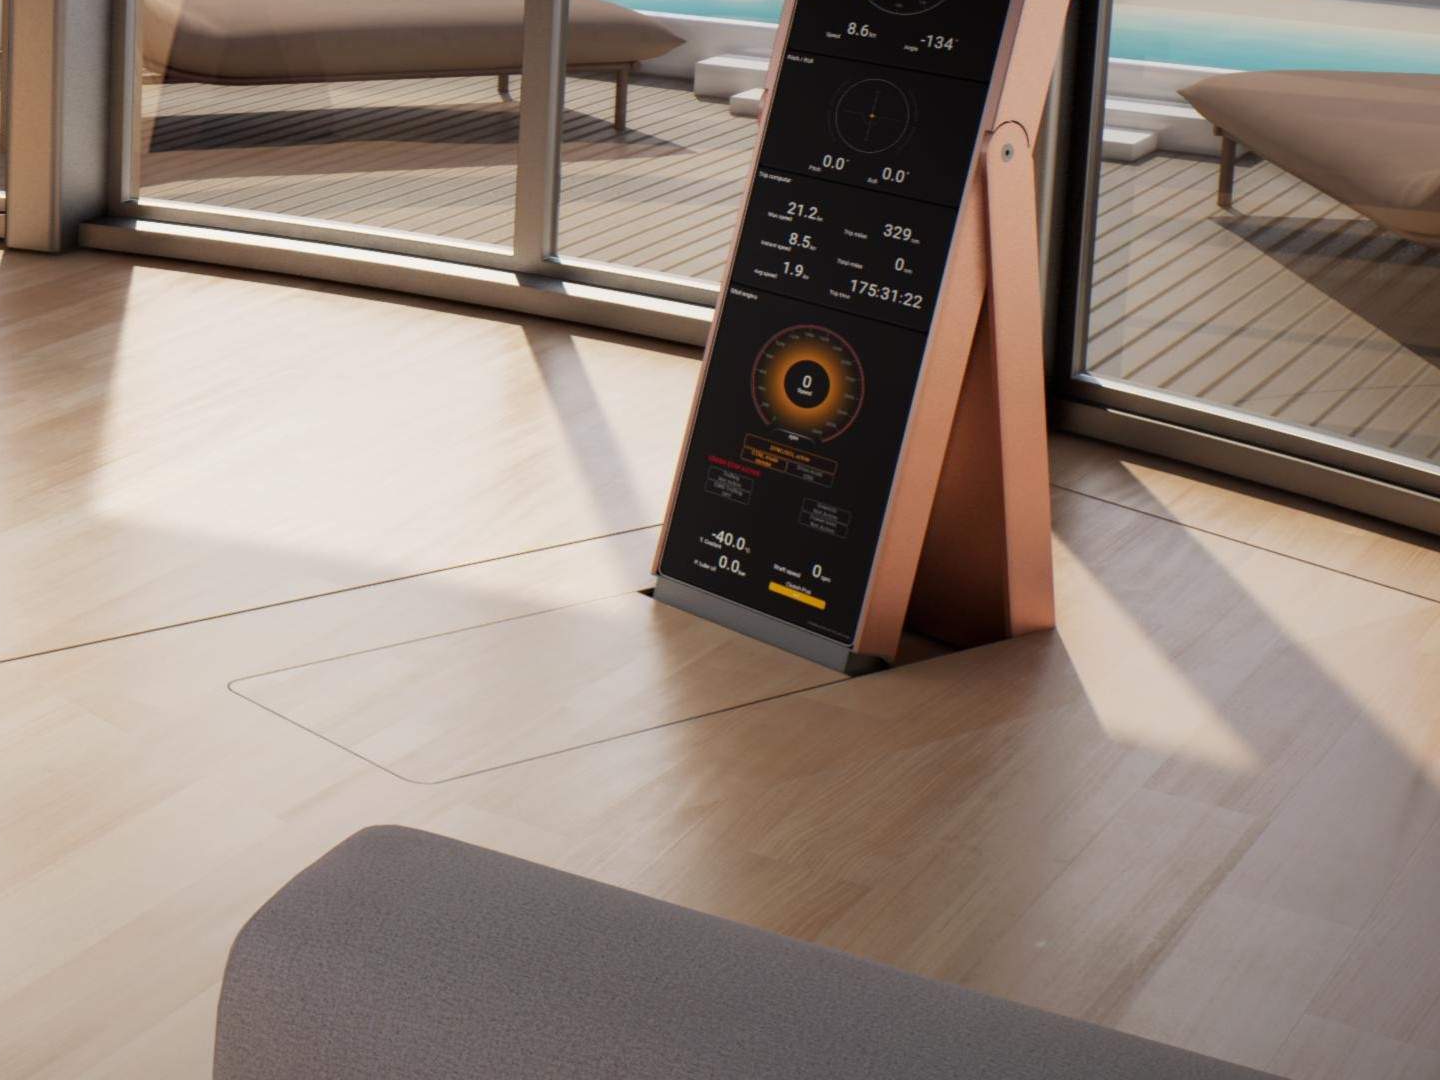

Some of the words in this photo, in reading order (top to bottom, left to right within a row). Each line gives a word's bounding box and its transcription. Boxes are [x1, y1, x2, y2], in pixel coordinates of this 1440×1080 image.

[846, 22, 869, 38] 8.6
[786, 201, 819, 221] 21.2
[788, 232, 812, 249] 8.5
[883, 223, 913, 242] 329
[783, 261, 805, 278] 1.9
[894, 258, 905, 272] 0
[850, 279, 924, 309] 175:31:22
[802, 374, 812, 388] 0
[711, 530, 746, 551] -40.0
[718, 555, 740, 574] 0.0
[812, 563, 822, 579] 0
